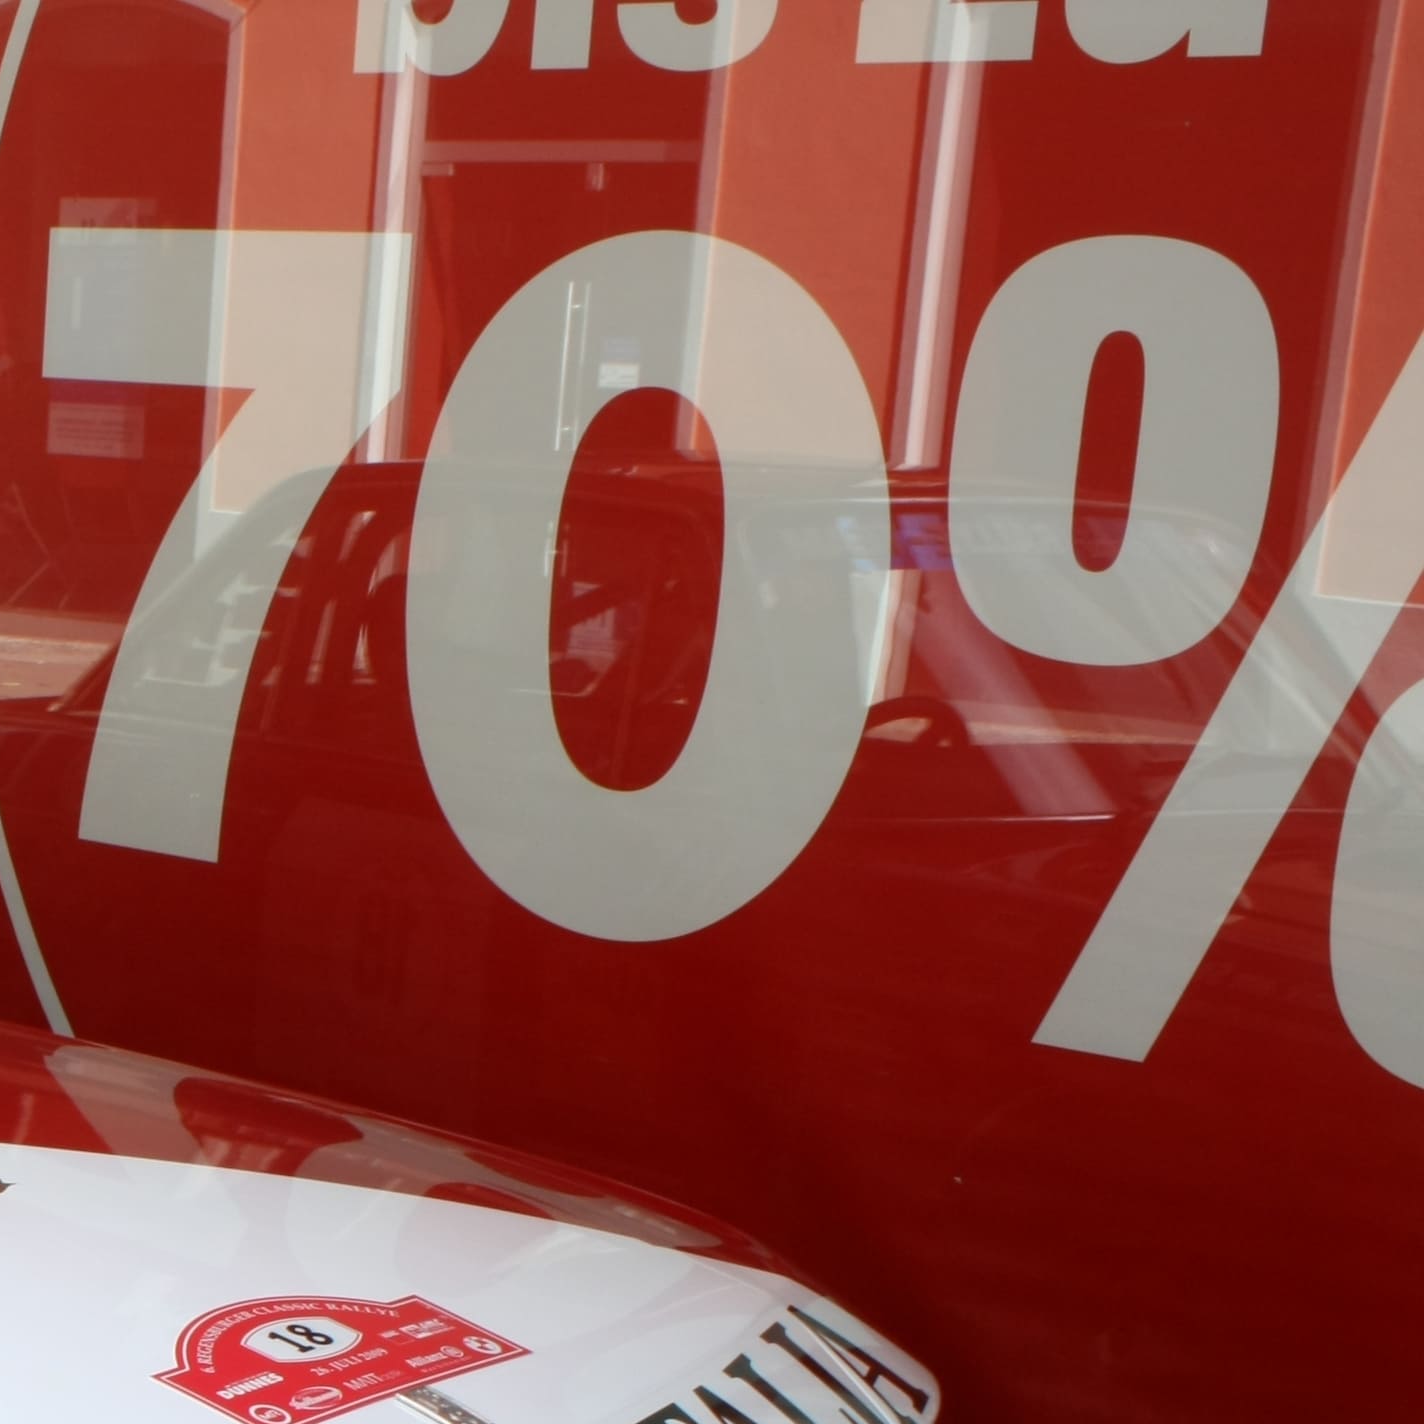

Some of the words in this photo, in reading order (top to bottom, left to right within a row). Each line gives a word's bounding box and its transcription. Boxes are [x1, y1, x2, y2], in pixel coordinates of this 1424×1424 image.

[41, 226, 1424, 1095] 70%
[252, 1302, 324, 1316] CLASSIC
[324, 1302, 401, 1319] RALLYE
[267, 1323, 335, 1354] 18
